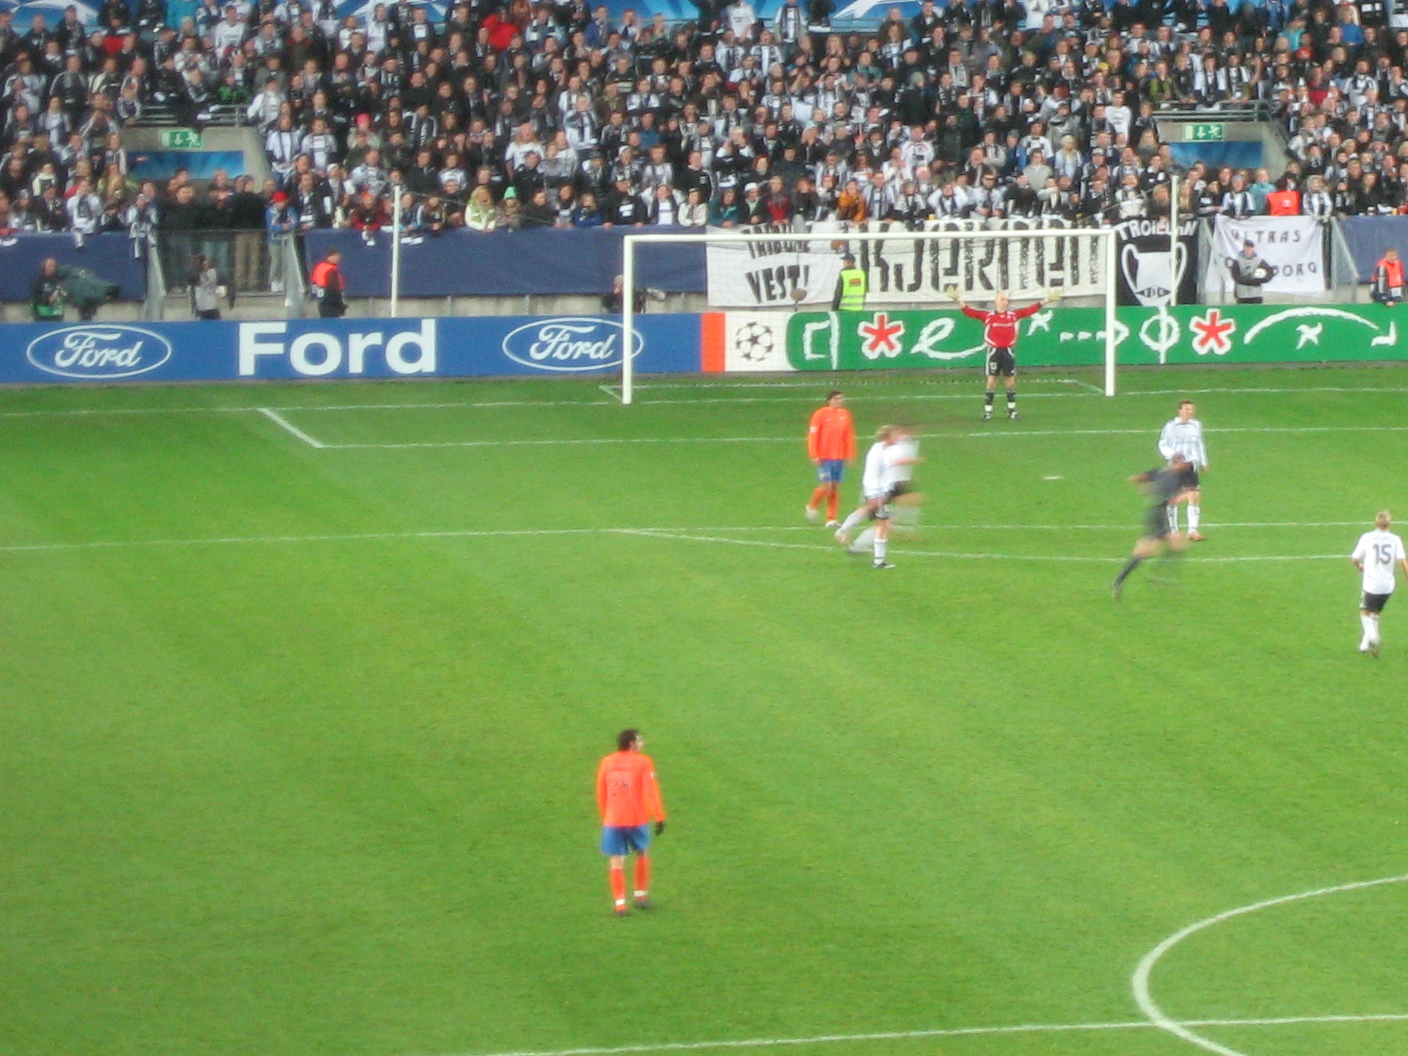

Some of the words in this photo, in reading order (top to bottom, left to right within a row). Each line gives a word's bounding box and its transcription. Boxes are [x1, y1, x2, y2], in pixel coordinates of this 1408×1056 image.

[54, 331, 144, 368] Ford
[239, 318, 436, 376] Ford
[529, 324, 617, 361] Ford
[1373, 543, 1391, 565] 15
